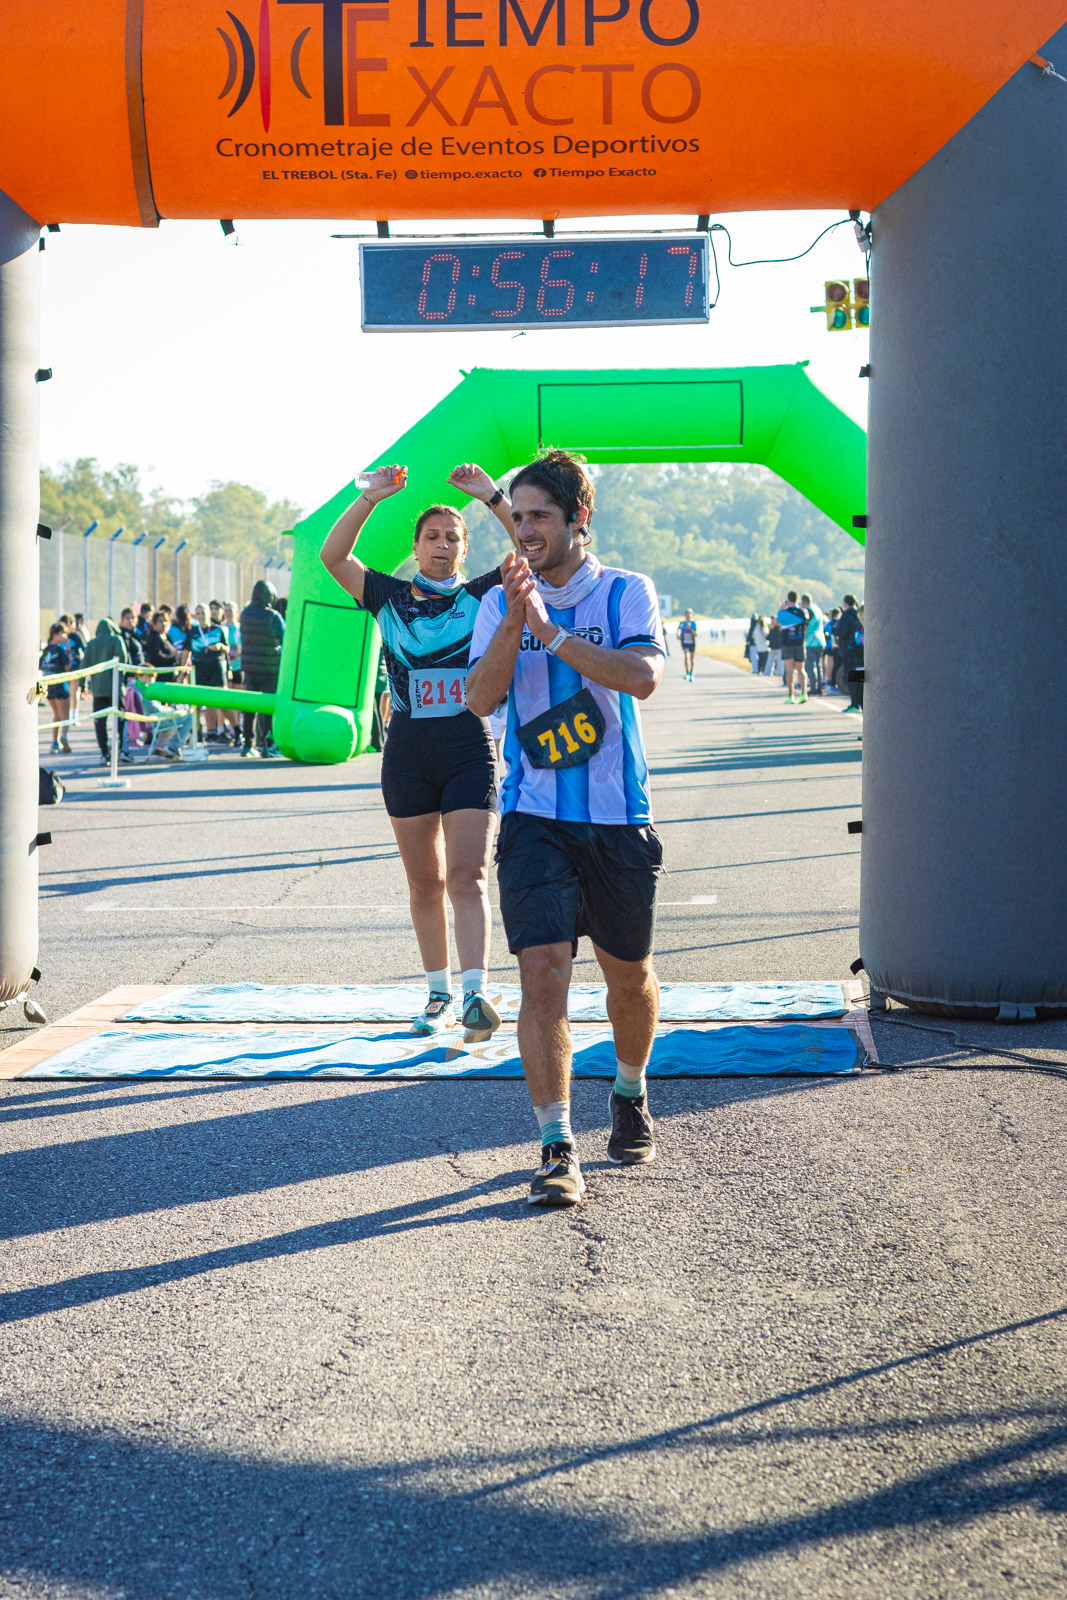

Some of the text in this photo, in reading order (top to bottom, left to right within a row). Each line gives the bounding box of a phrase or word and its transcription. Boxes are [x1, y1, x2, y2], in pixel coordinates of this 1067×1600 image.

[216, 134, 700, 161] Cronometraje de Eventos Deportivos
[262, 170, 279, 180] EL
[281, 170, 338, 180] TREBOL
[341, 169, 373, 181] (Sta.
[376, 169, 397, 181] Fe)
[549, 167, 657, 179] Tiempo Exacto
[418, 246, 698, 319] 0:56:17
[421, 678, 463, 705] 214
[537, 712, 596, 763] 716
